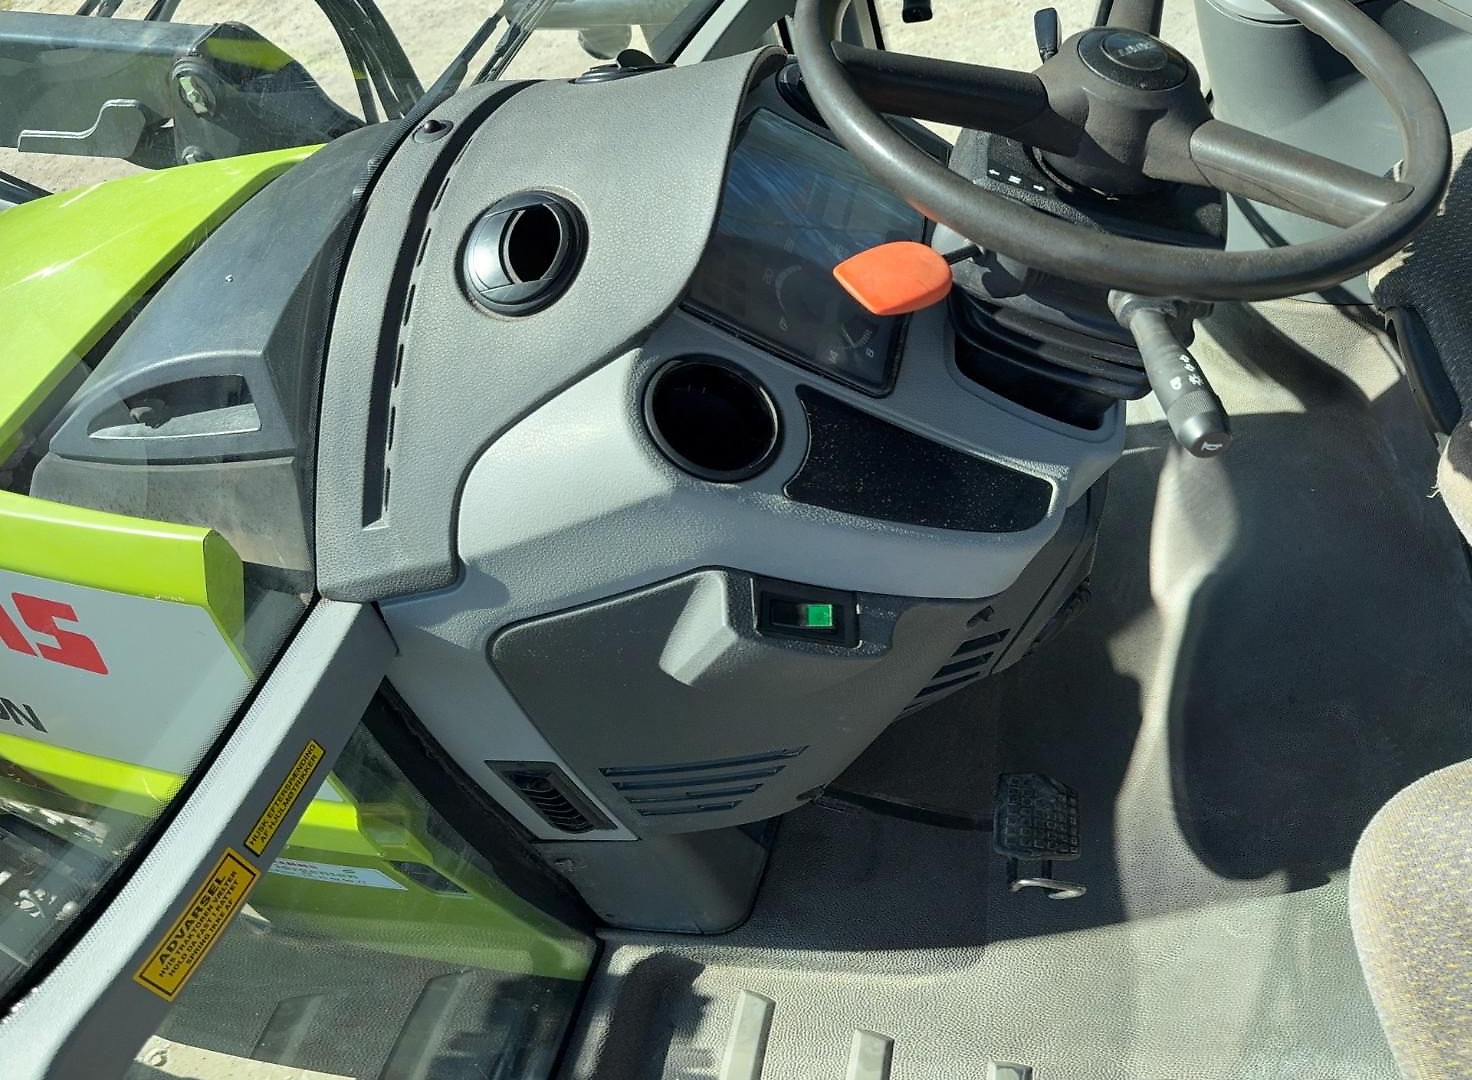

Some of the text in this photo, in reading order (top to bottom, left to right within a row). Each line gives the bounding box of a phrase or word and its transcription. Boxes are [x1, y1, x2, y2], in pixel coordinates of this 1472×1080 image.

[249, 820, 269, 845] HUSK
[158, 957, 177, 978] HVIS
[176, 904, 214, 956] TRAKTOREN
[159, 876, 226, 965] ADVARSEL
[168, 953, 188, 977] HOLD
[186, 940, 198, 952] DA
[196, 917, 213, 939] FAST
[185, 932, 210, 965] SPRING
[209, 911, 226, 932] IKKE
